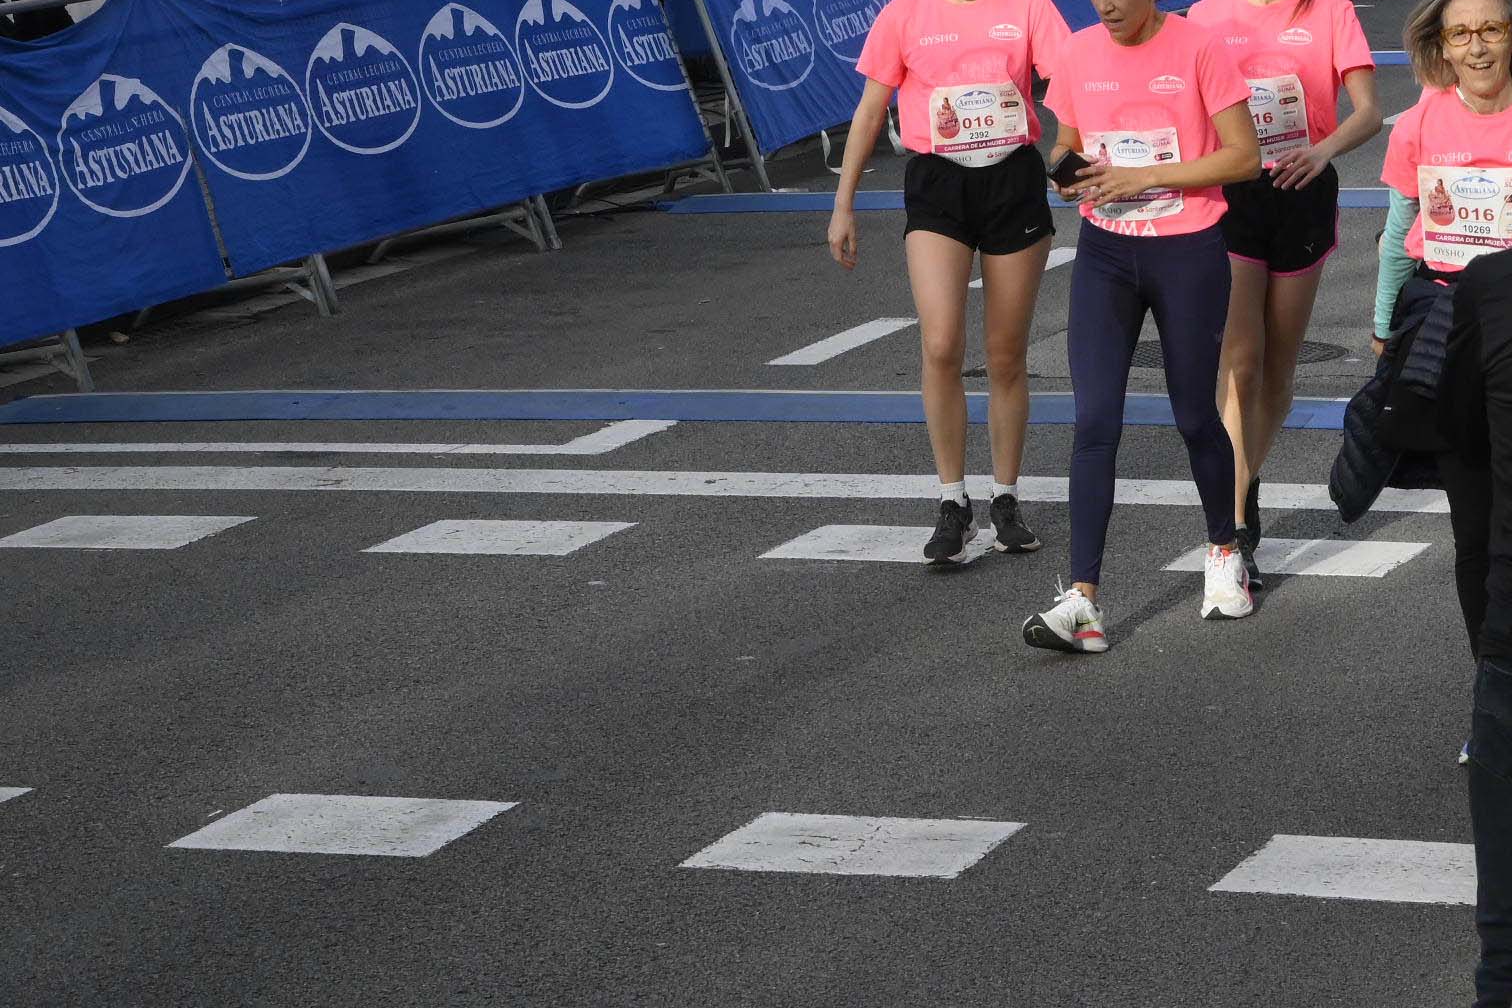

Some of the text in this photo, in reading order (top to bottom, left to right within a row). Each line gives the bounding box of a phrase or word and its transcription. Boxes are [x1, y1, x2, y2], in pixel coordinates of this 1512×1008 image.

[618, 23, 679, 67] ASTUR
[920, 33, 959, 46] OYSHO
[524, 39, 609, 84] ASTURIANA
[429, 53, 521, 102] ASTURIANA
[316, 77, 417, 128] ASTURIANA
[958, 96, 993, 108] ASTURIANA
[962, 115, 995, 129] 016
[1253, 112, 1273, 125] 16
[82, 123, 123, 143] CENTRAL
[203, 101, 306, 153] ASTURIANA
[969, 130, 989, 140] 2392
[70, 129, 184, 190] ASTURIANA
[1432, 152, 1472, 163] OYSHO
[1455, 184, 1496, 194] ASTURIANA
[1458, 207, 1495, 221] 016
[1463, 224, 1491, 234] 10269
[1435, 234, 1465, 243] CARRERA
[1465, 236, 1475, 244] DE
[1434, 246, 1465, 258] OYSHO
